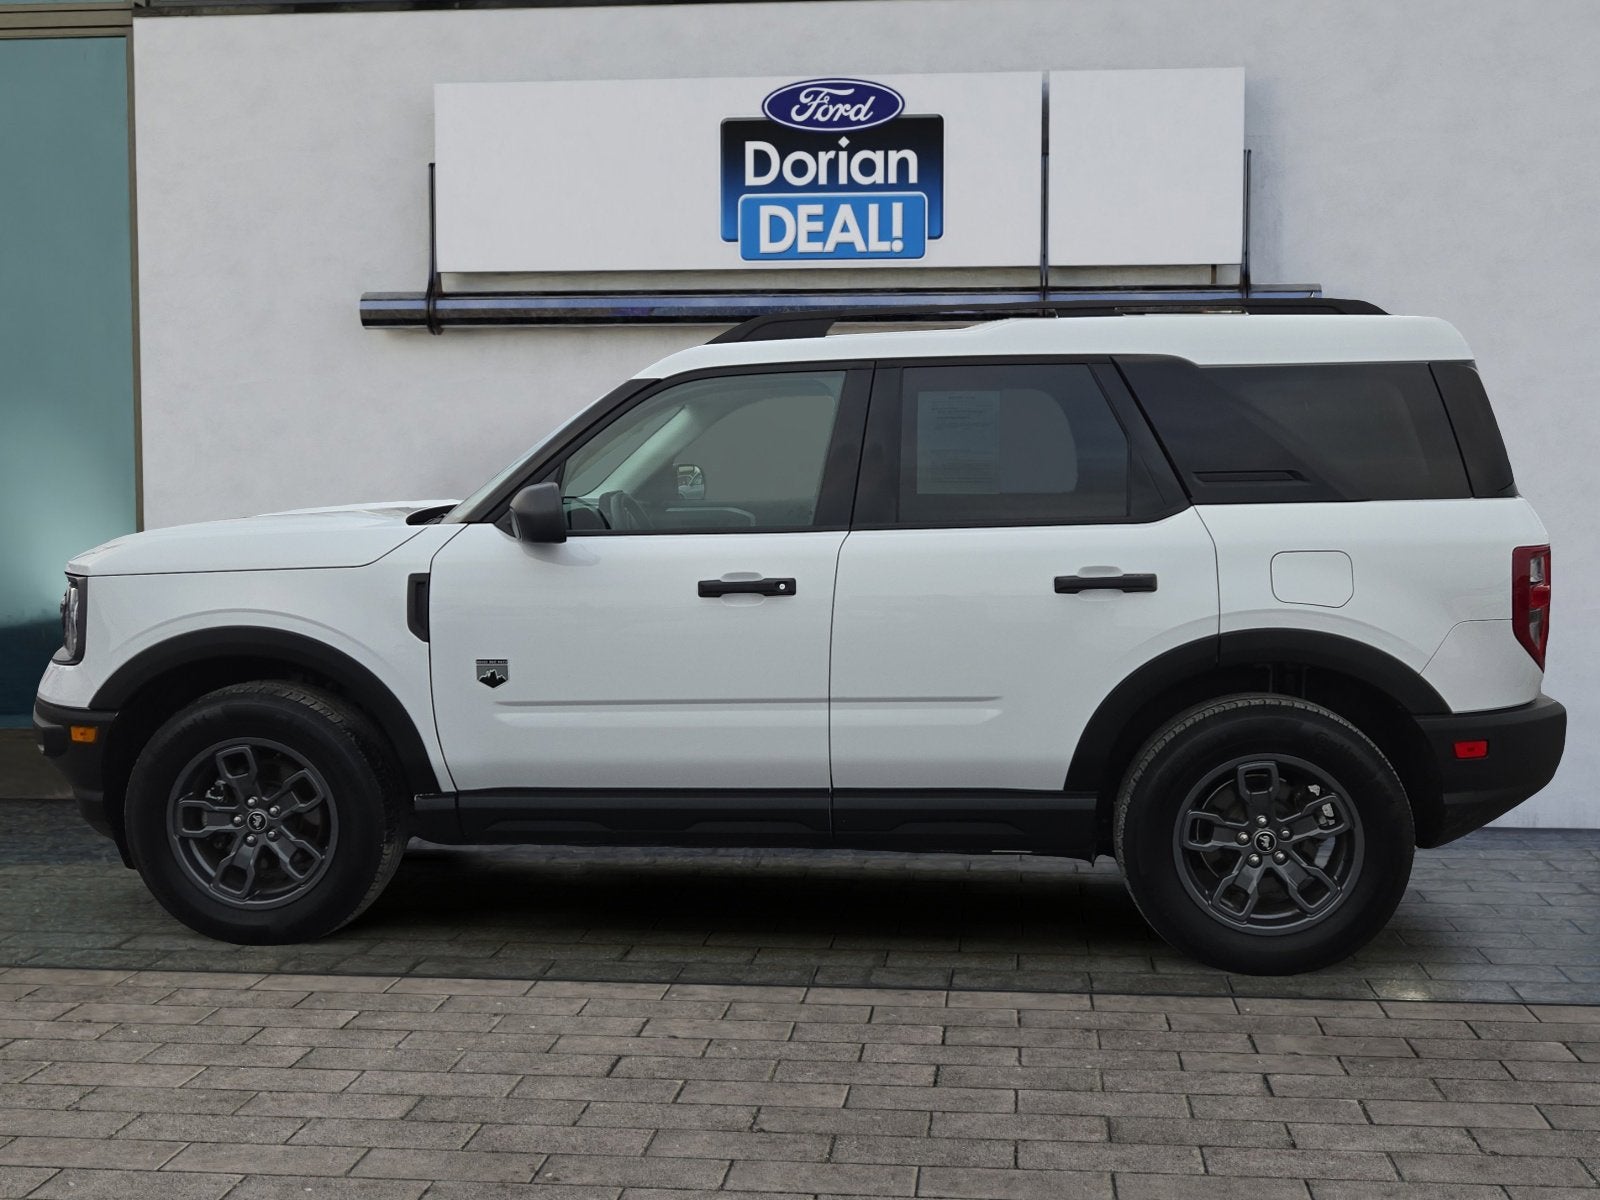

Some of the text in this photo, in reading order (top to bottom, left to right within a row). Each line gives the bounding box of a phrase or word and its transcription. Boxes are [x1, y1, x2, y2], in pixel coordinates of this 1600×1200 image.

[790, 87, 876, 122] Ford
[744, 135, 919, 187] Dorian
[759, 202, 904, 254] DEAL!
